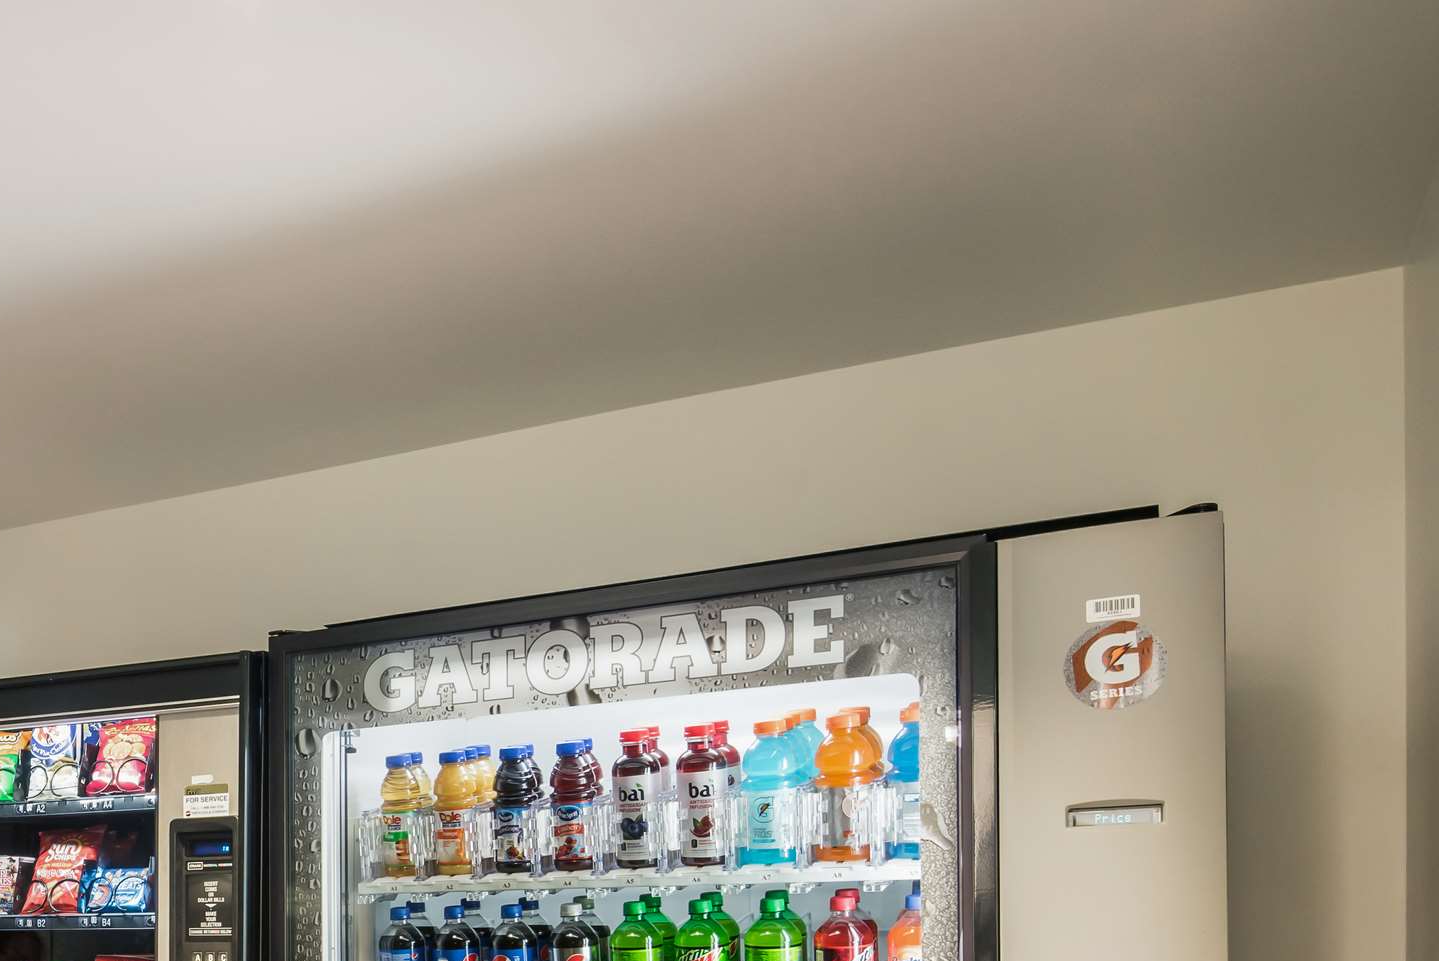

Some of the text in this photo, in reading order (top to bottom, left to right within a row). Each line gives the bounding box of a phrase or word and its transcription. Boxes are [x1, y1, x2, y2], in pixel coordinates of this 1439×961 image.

[363, 595, 844, 713] GATORADE
[1090, 686, 1143, 701] SERIES
[36, 805, 46, 814] A2
[103, 800, 113, 809] A4
[102, 918, 111, 926] B4
